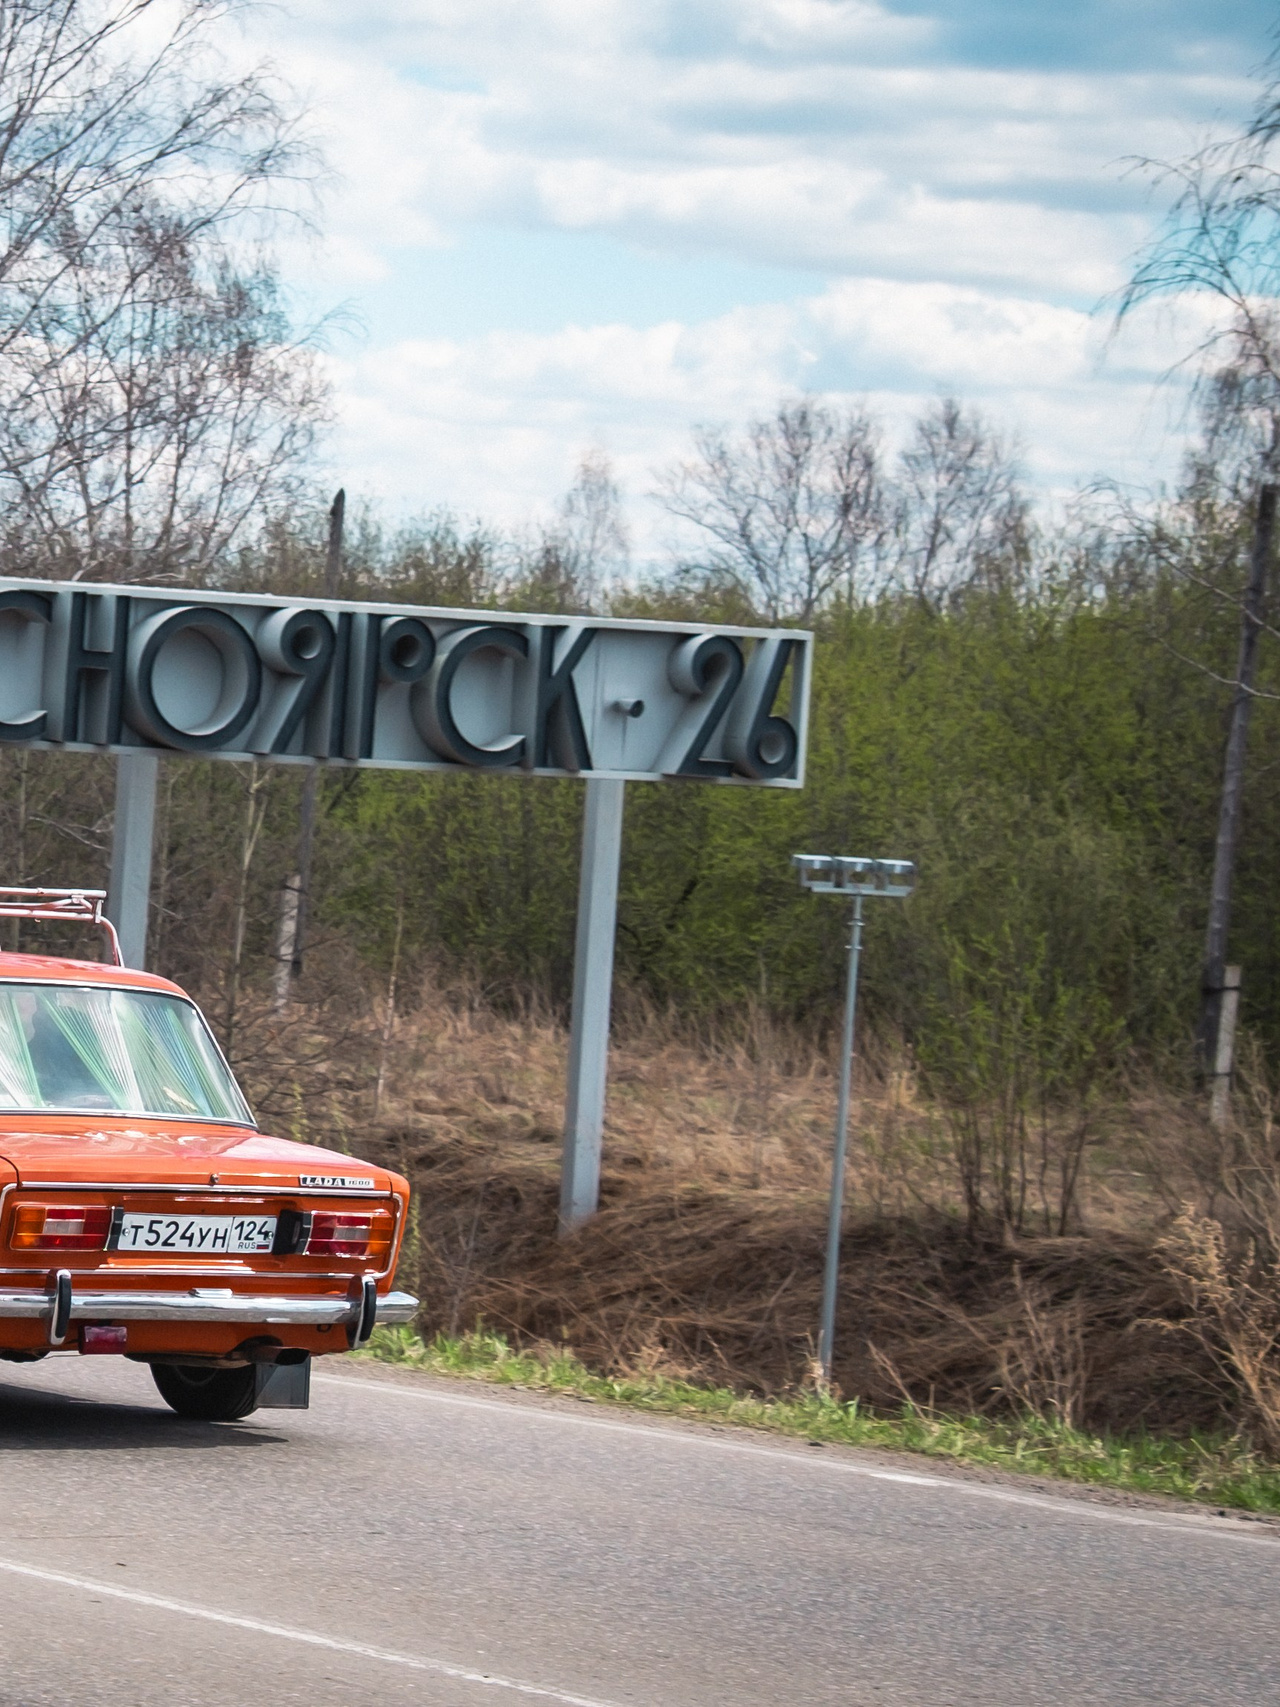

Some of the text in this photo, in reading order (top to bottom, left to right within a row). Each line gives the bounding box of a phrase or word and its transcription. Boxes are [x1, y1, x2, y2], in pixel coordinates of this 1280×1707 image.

[306, 1176, 342, 1187] LADA
[130, 1219, 270, 1249] Т524УН 124
[237, 1241, 256, 1250] RUS
